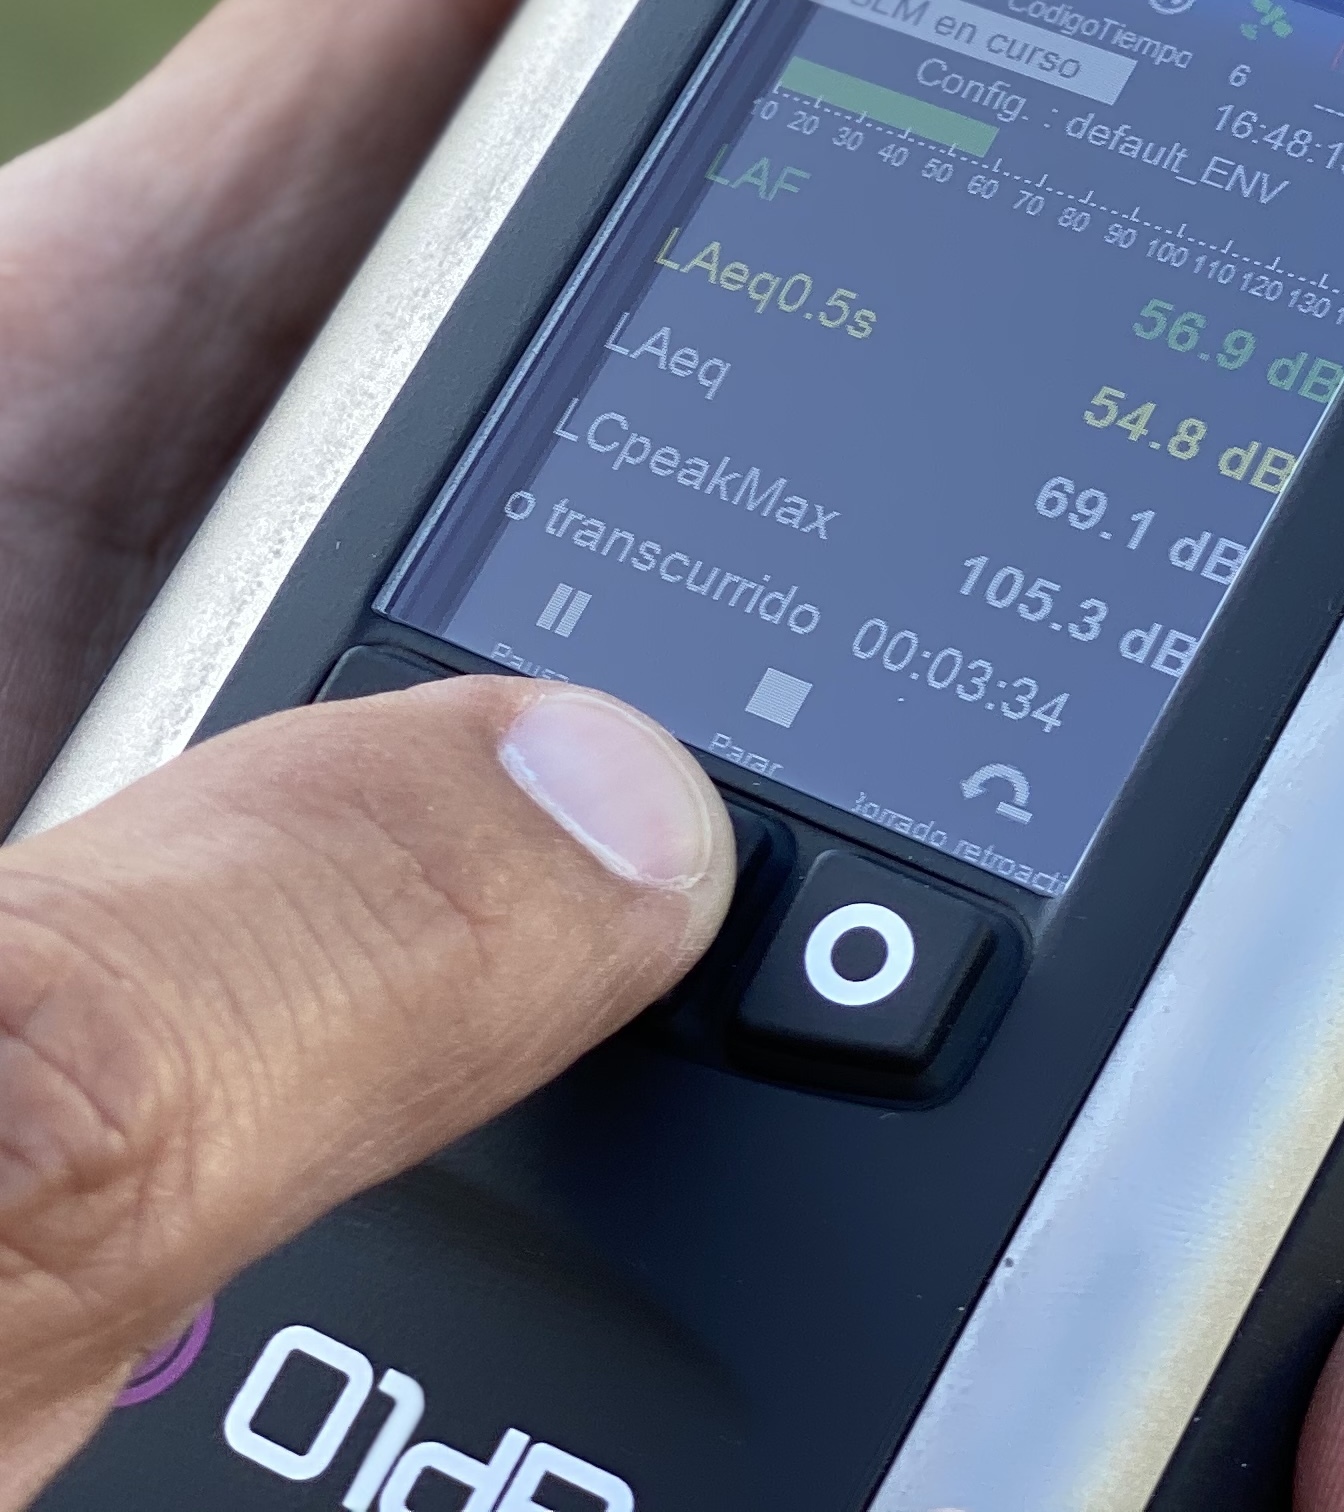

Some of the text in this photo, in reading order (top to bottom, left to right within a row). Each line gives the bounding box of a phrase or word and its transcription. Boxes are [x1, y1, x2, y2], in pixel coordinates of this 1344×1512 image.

[934, 14, 978, 45] en
[986, 32, 1081, 80] curso
[1064, 112, 1291, 205] default_ENV
[1227, 64, 1252, 88] 6
[704, 142, 813, 202] LAF
[1131, 297, 1257, 371] 56.9
[786, 109, 821, 136] 20
[831, 126, 865, 152] 30
[877, 143, 909, 168] 40
[921, 157, 955, 184] 50
[966, 174, 1000, 200] 60
[1012, 188, 1046, 217] 70
[1057, 206, 1092, 233] 80
[1103, 222, 1139, 250] 90
[1145, 238, 1190, 268] 100
[1192, 254, 1237, 286] 110
[1239, 271, 1285, 302] 120
[1287, 288, 1332, 319] 130
[603, 311, 1250, 586] LAeq 69.1 dB
[654, 226, 1300, 495] LAeq0.5s 54.8 dB
[544, 496, 822, 636] transcurrido
[851, 617, 1072, 735] 00:03:34
[552, 397, 1200, 679] LCpeakMax 105.3 dB
